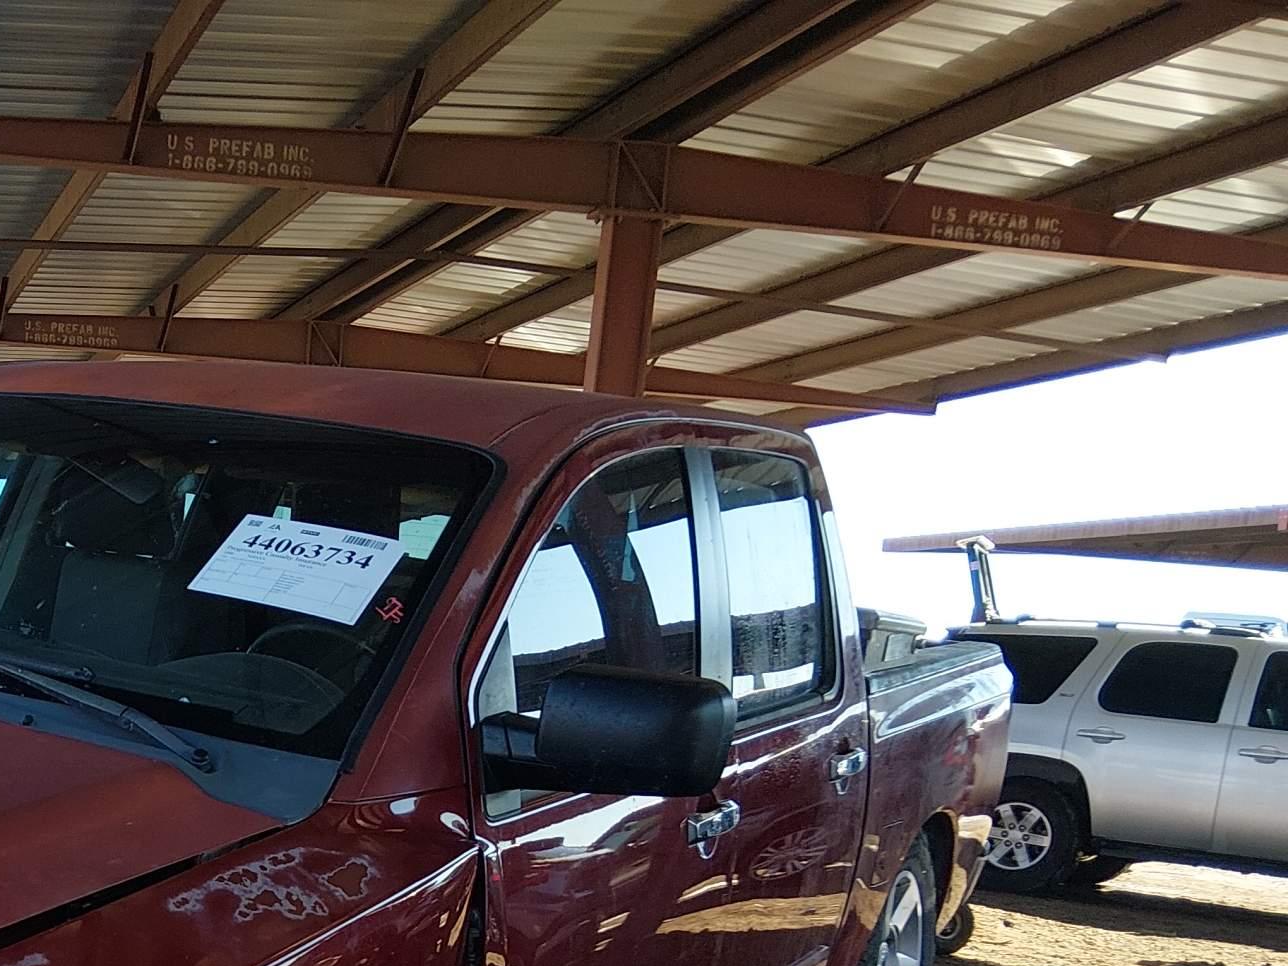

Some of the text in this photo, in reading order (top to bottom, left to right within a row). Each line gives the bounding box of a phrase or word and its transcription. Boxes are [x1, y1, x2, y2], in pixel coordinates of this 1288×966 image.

[208, 137, 275, 161] PREFAB
[282, 143, 315, 163] INC.
[967, 208, 1028, 230] PREFAB
[1035, 215, 1065, 234] INC.
[50, 321, 93, 336] PREFAB
[242, 533, 375, 570] 44063734
